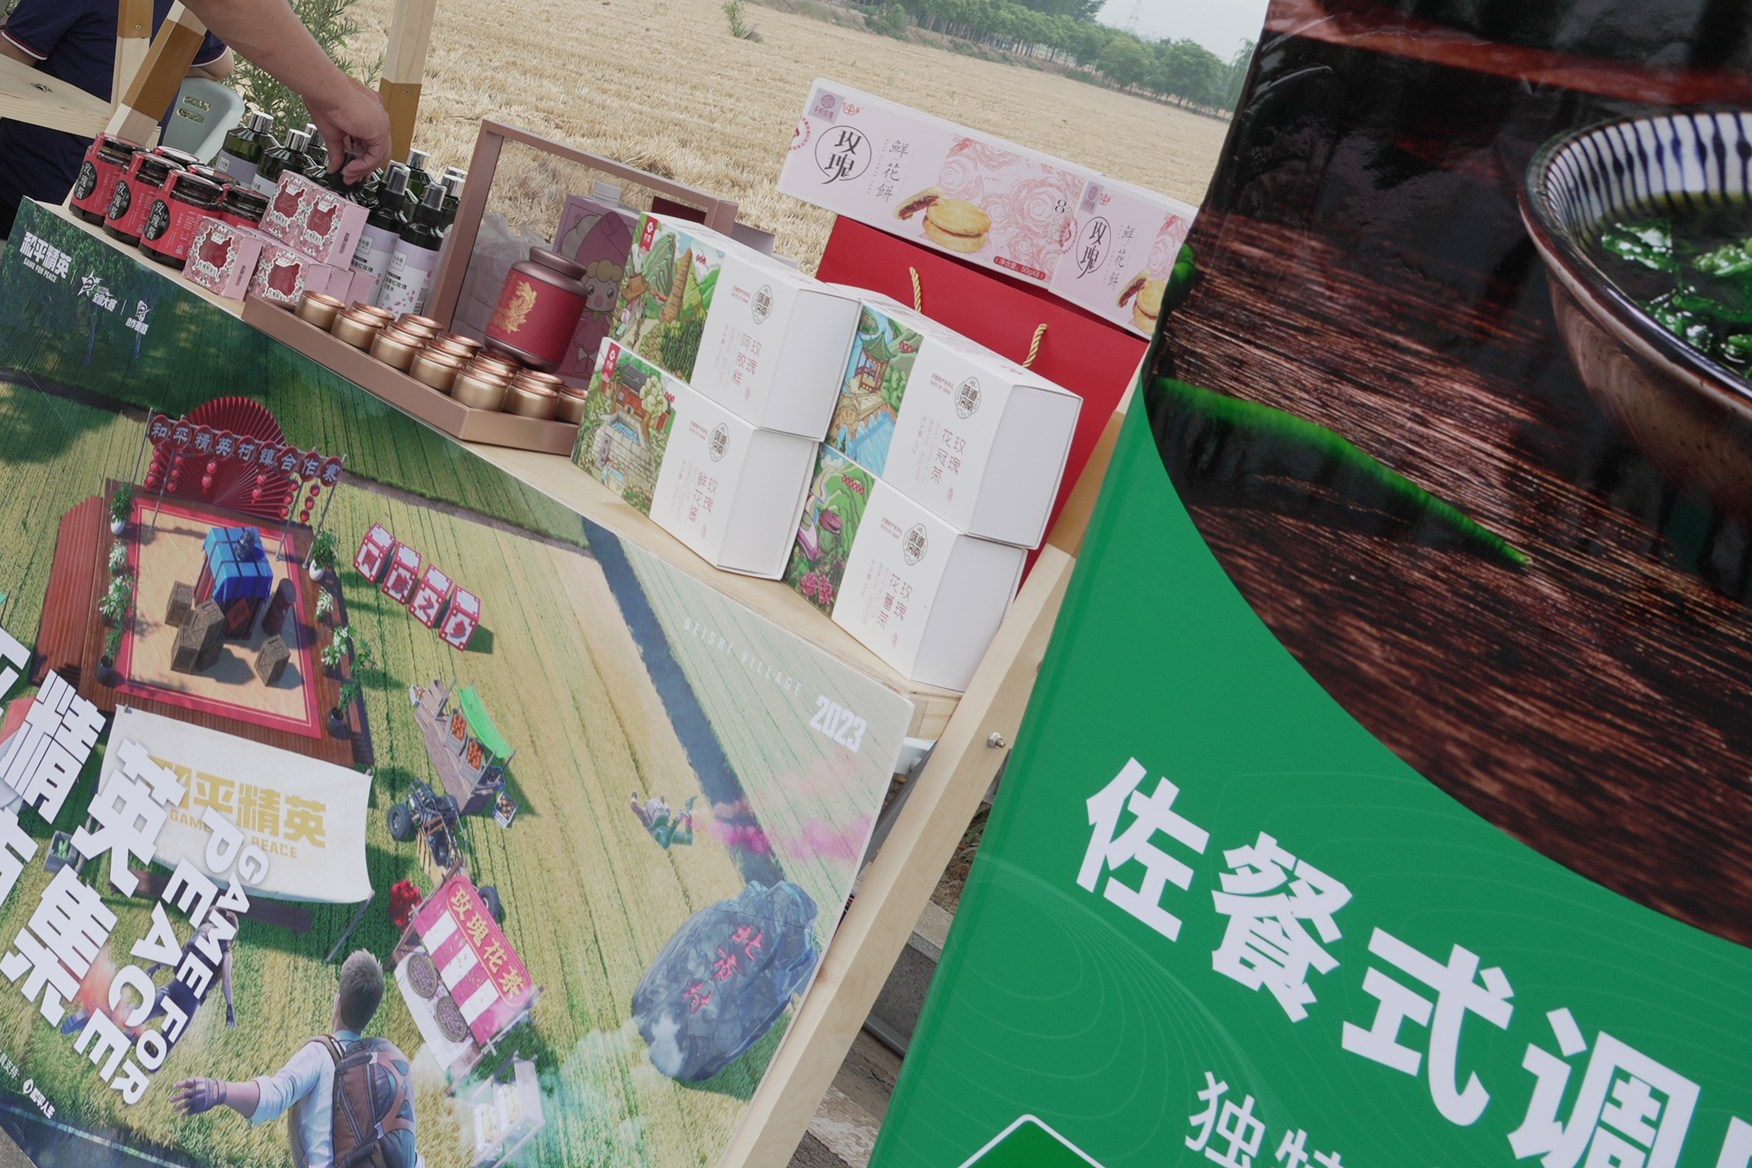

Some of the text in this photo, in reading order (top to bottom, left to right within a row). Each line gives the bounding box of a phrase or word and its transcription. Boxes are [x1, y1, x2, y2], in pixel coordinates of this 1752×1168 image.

[821, 128, 862, 185] 玫瑰
[1054, 199, 1067, 214] 8
[19, 231, 73, 279] 和平精英
[23, 257, 58, 284] GAME FOR PEACE
[1076, 221, 1107, 280] 玫瑰
[930, 428, 954, 485] 花冠茶
[946, 435, 967, 476] 玫瑰
[894, 581, 914, 622] 玫瑰
[683, 617, 803, 697] BEISHI VILLAGE
[809, 694, 867, 753] 2023
[250, 835, 298, 859] PEACE
[74, 806, 246, 1084] PEACE
[450, 885, 525, 1000] 玫瑰花茶
[1074, 756, 1752, 1168] 佐餐式调
[111, 843, 270, 1107] GAME FOR
